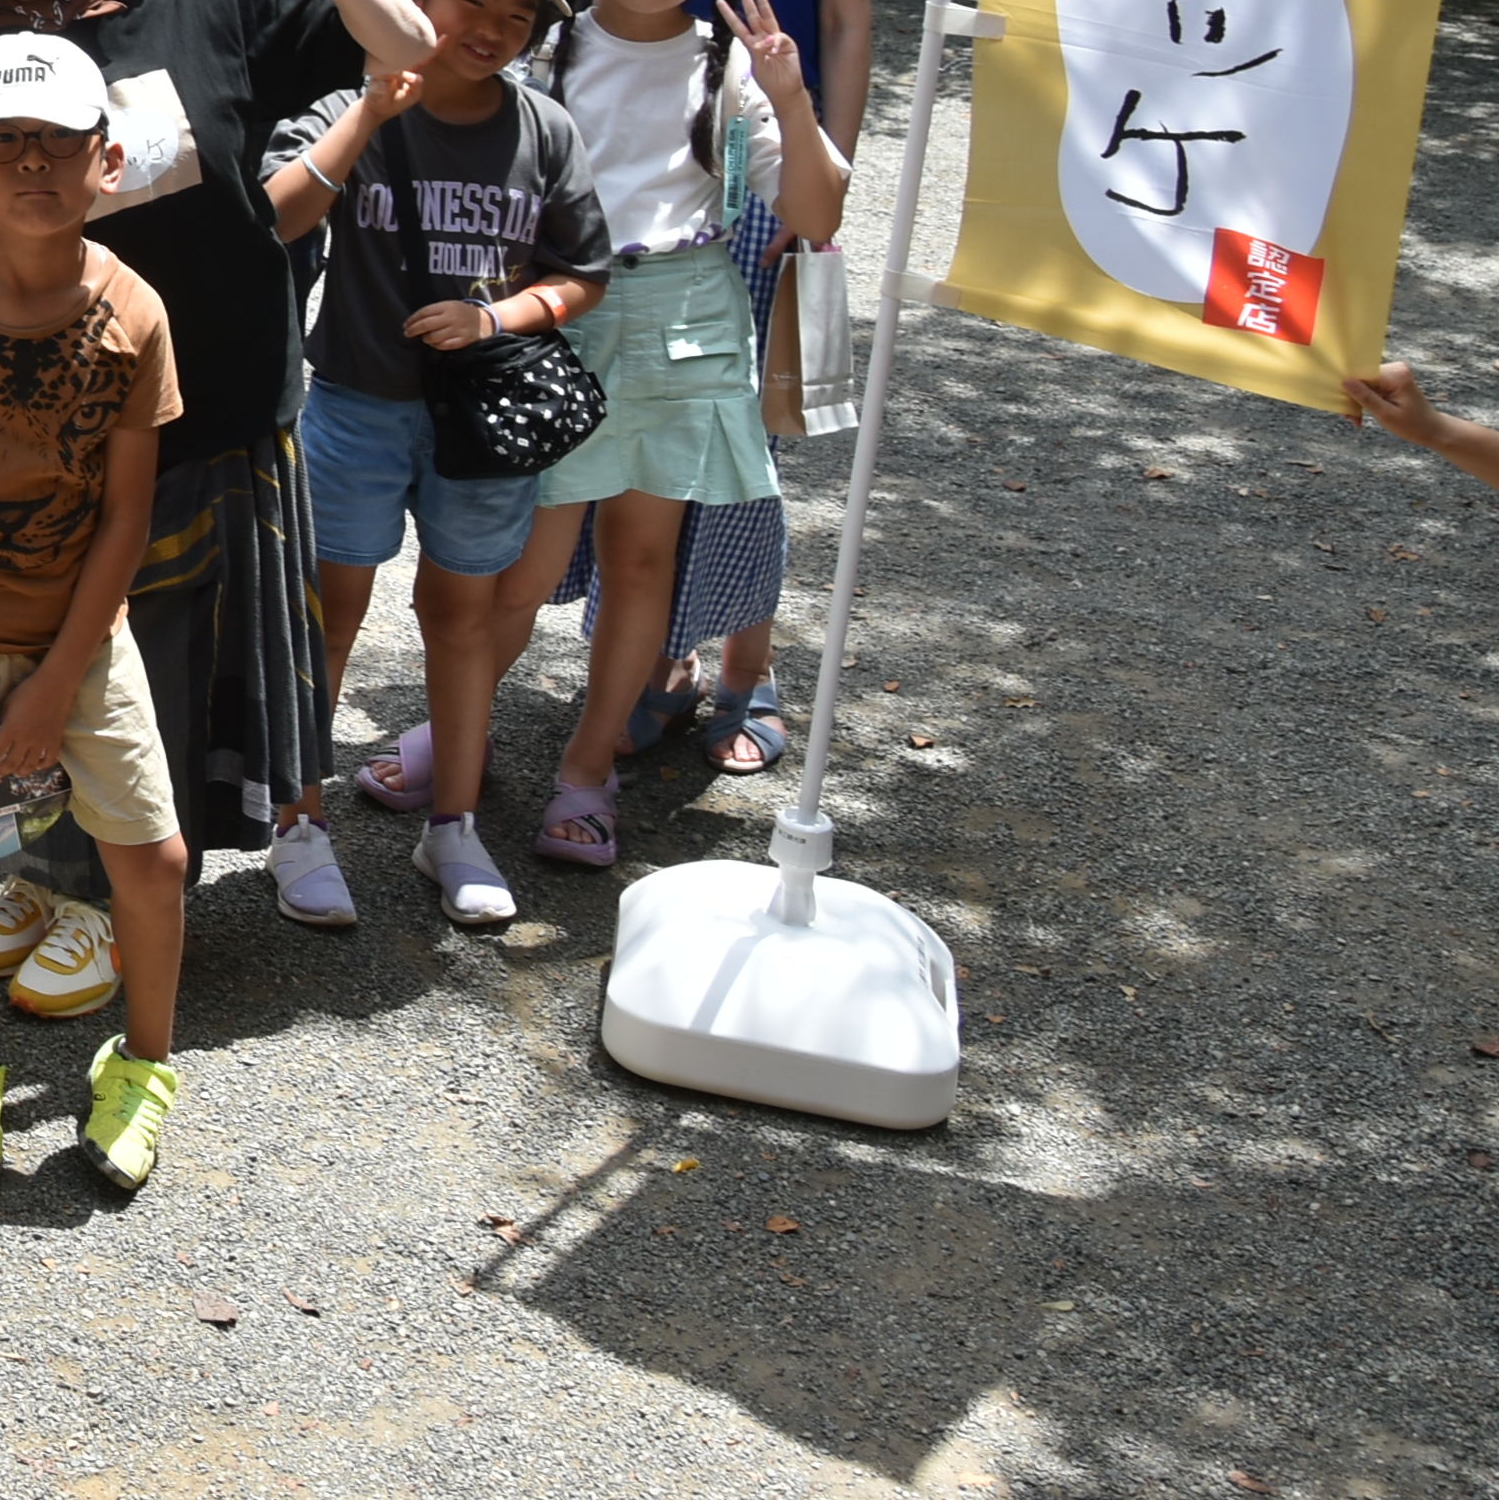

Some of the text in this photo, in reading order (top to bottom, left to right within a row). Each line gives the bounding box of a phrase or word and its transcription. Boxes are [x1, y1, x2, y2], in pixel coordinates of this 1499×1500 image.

[428, 241, 509, 278] HOLIDAY
[1237, 239, 1291, 334] 認定店
